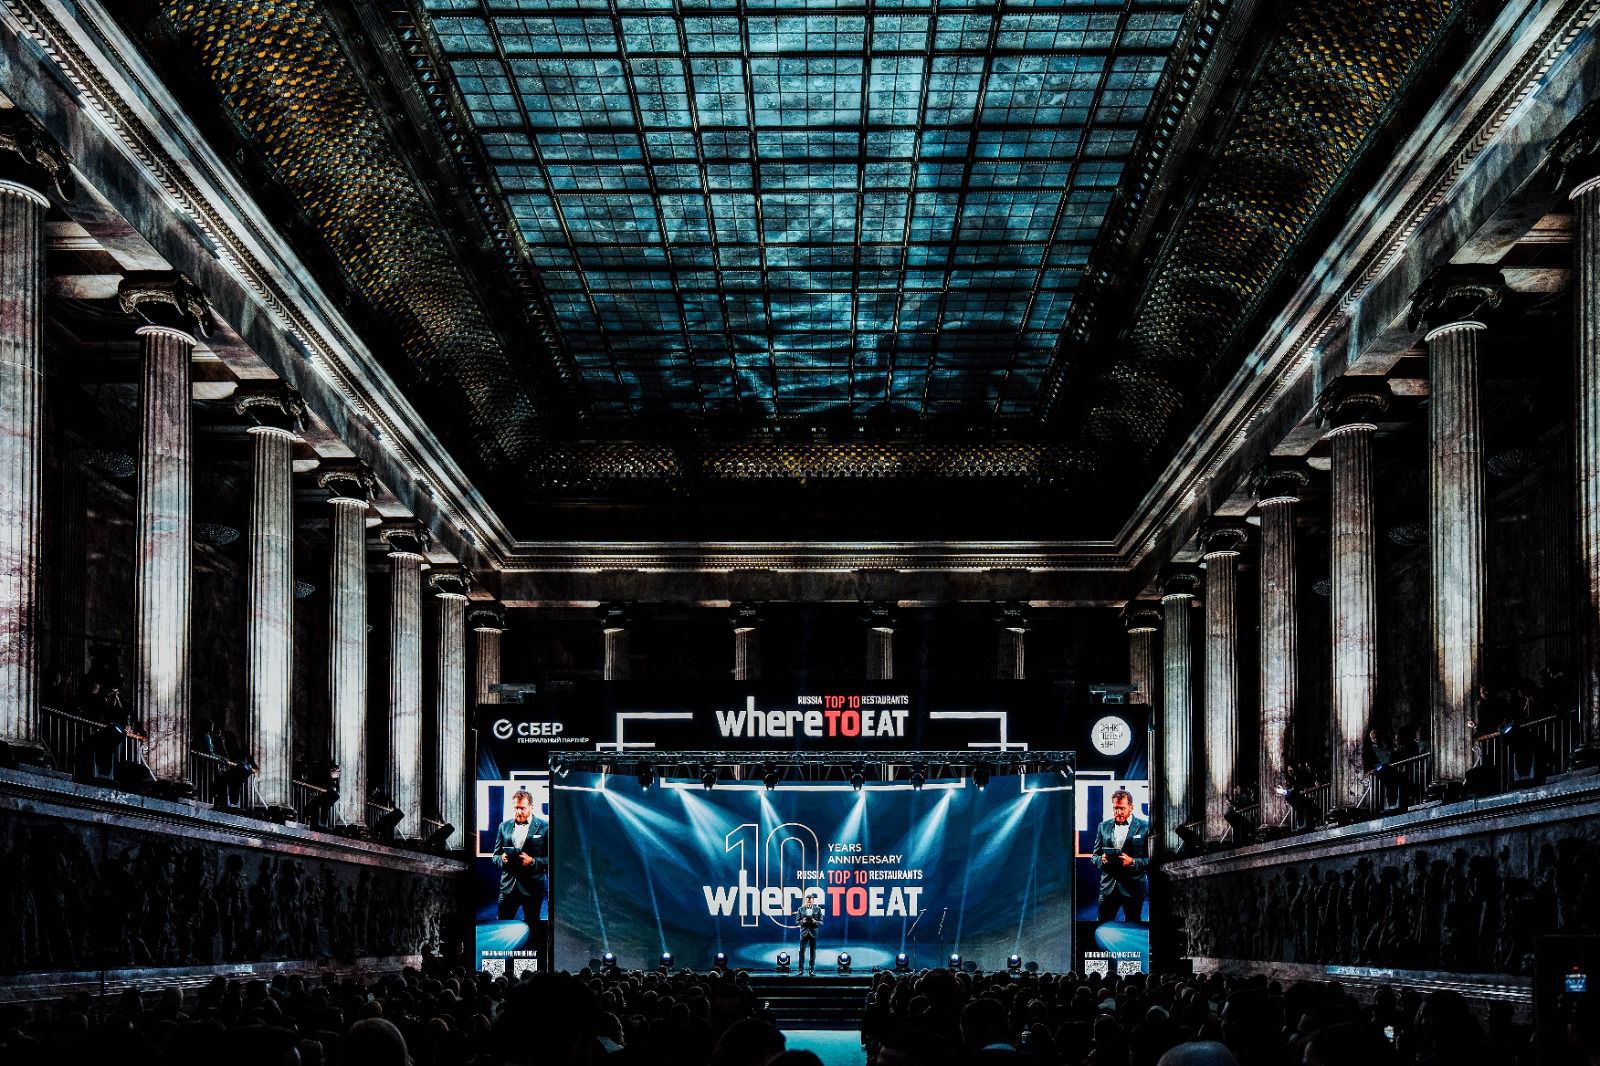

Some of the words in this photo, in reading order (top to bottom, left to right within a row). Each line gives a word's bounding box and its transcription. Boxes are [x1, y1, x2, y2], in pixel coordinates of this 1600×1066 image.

[797, 696, 823, 704] RUSSIA
[825, 696, 845, 708] TOP
[847, 696, 860, 708] 10
[861, 696, 909, 704] RESTAURANTS
[517, 722, 564, 736] СБЕР
[827, 843, 862, 852] YEARS
[827, 855, 902, 864] ANNIVERSARY
[725, 822, 819, 929] 10
[796, 870, 825, 880] RUSSIA
[827, 870, 850, 884] TOP
[854, 870, 867, 884] 10
[869, 870, 923, 880] RESTAURANTS
